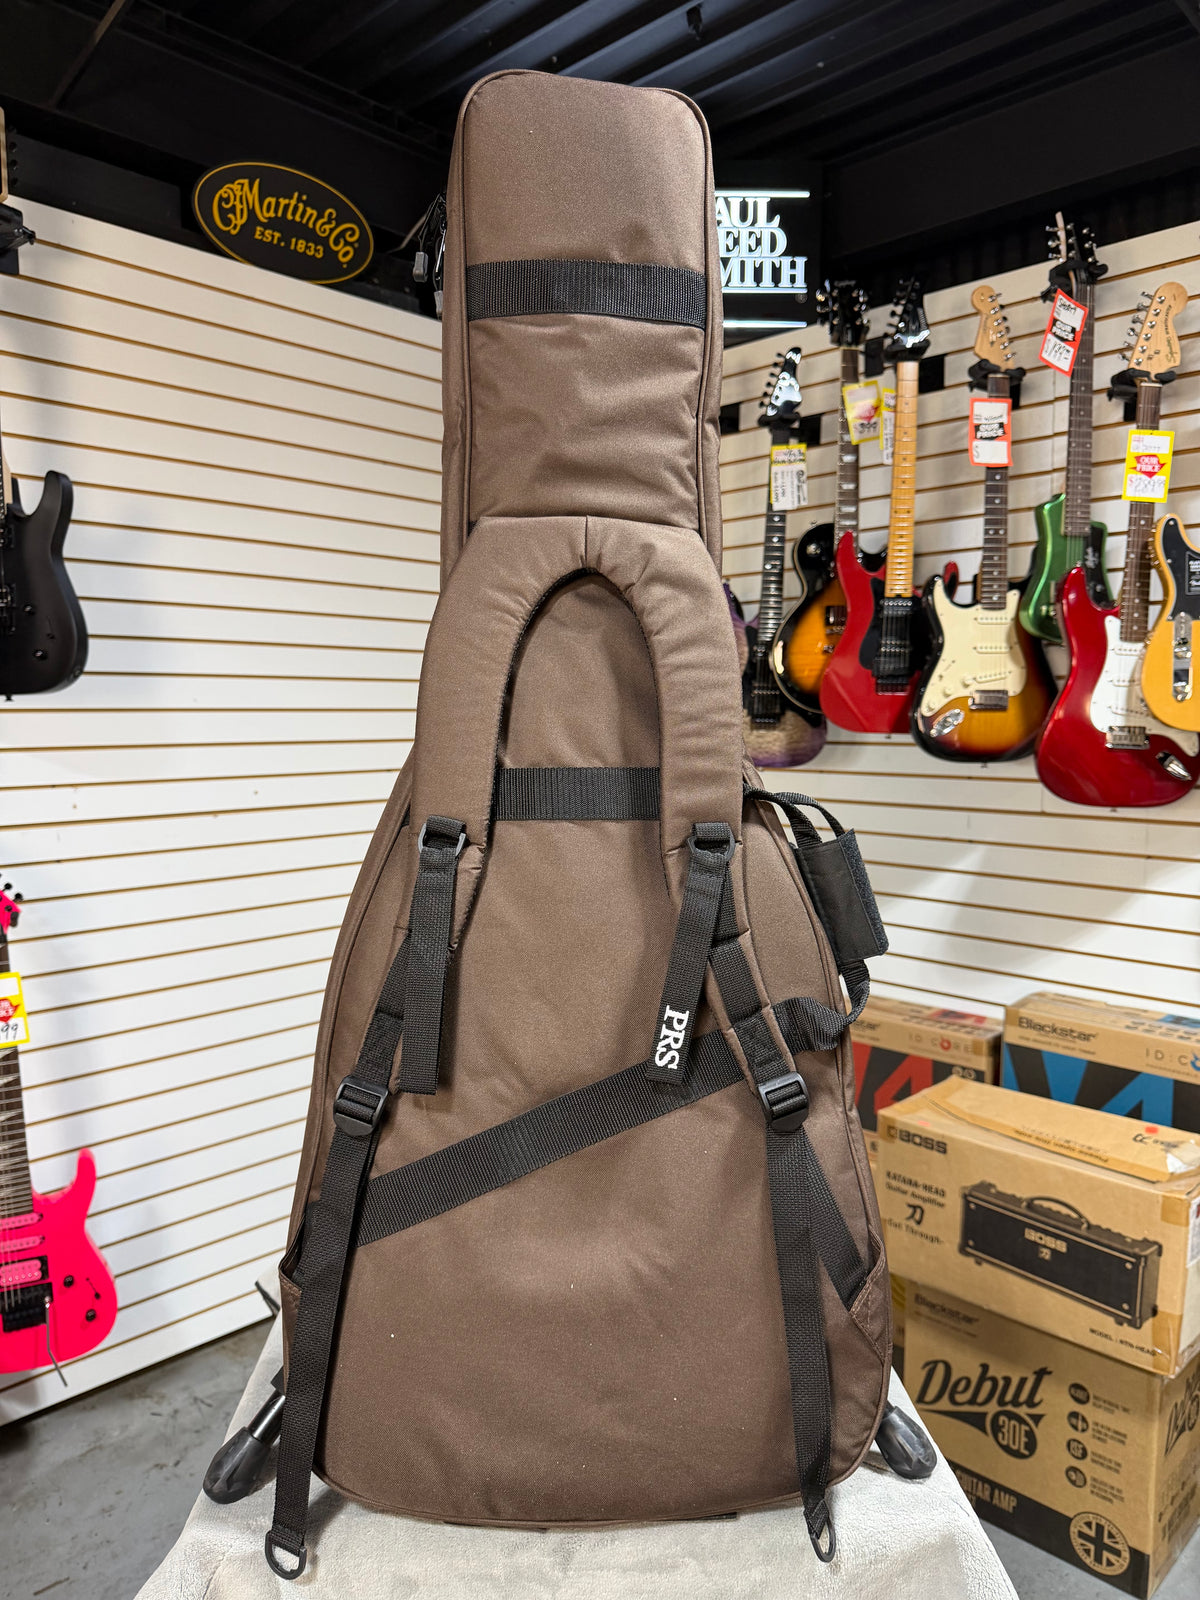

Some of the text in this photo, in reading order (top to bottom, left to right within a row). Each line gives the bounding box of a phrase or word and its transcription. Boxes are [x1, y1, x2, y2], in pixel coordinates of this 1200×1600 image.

[715, 196, 781, 228] AUL
[254, 226, 324, 259] EST. 1833
[717, 226, 788, 258] EED
[719, 256, 808, 288] MITH
[654, 1004, 690, 1070] PRS
[1018, 1016, 1098, 1042] Blackstar
[898, 1128, 948, 1155] BOSS
[1024, 1227, 1067, 1254] BOSS
[914, 1358, 1054, 1409] Debut
[997, 1414, 1031, 1456] 30E
[992, 1486, 1018, 1514] AMP
